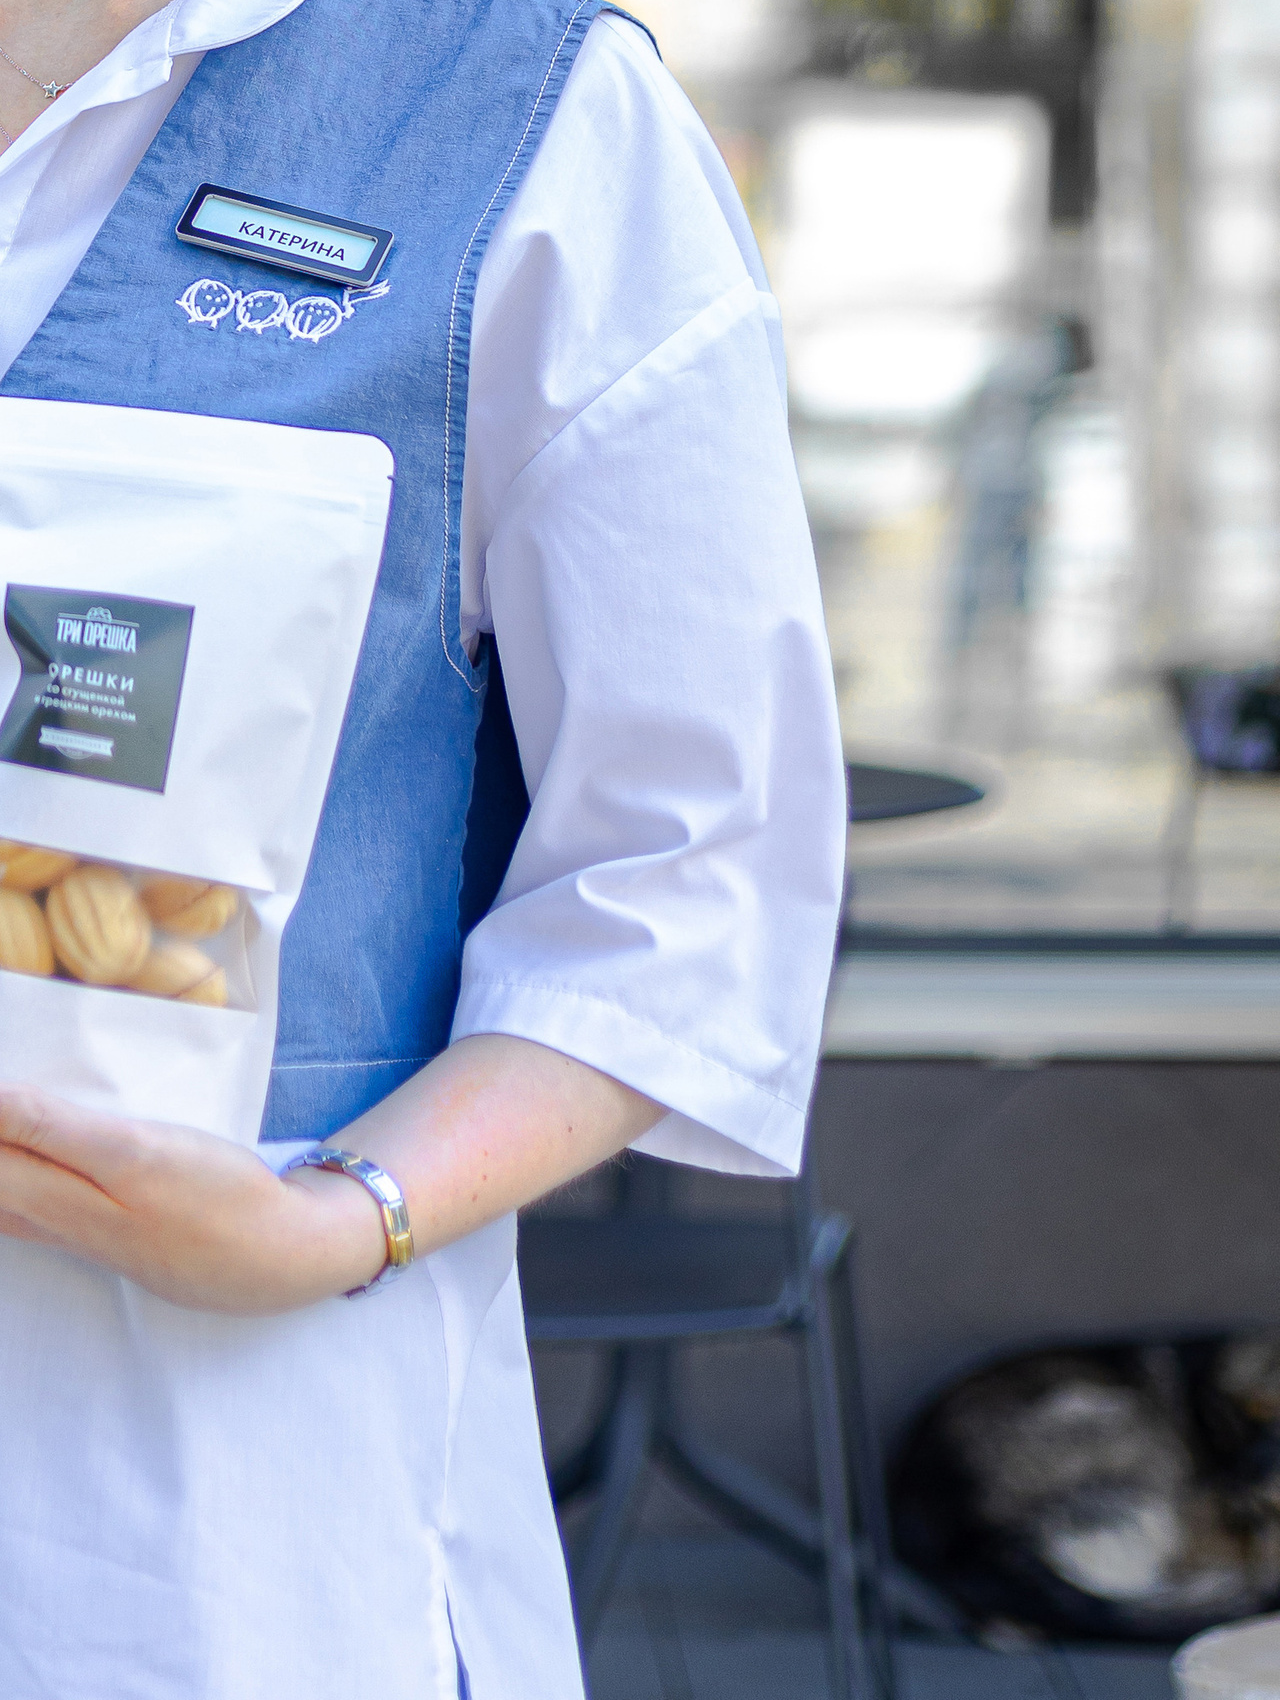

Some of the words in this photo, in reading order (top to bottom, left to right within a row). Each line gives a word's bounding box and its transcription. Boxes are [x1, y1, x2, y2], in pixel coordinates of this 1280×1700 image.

[238, 221, 345, 261] КАТЕРИНА
[57, 618, 82, 645] ТРИ
[83, 620, 136, 653] ОРЕШКА
[48, 662, 134, 693] ОРЕШКИ
[91, 705, 136, 722] орехом
